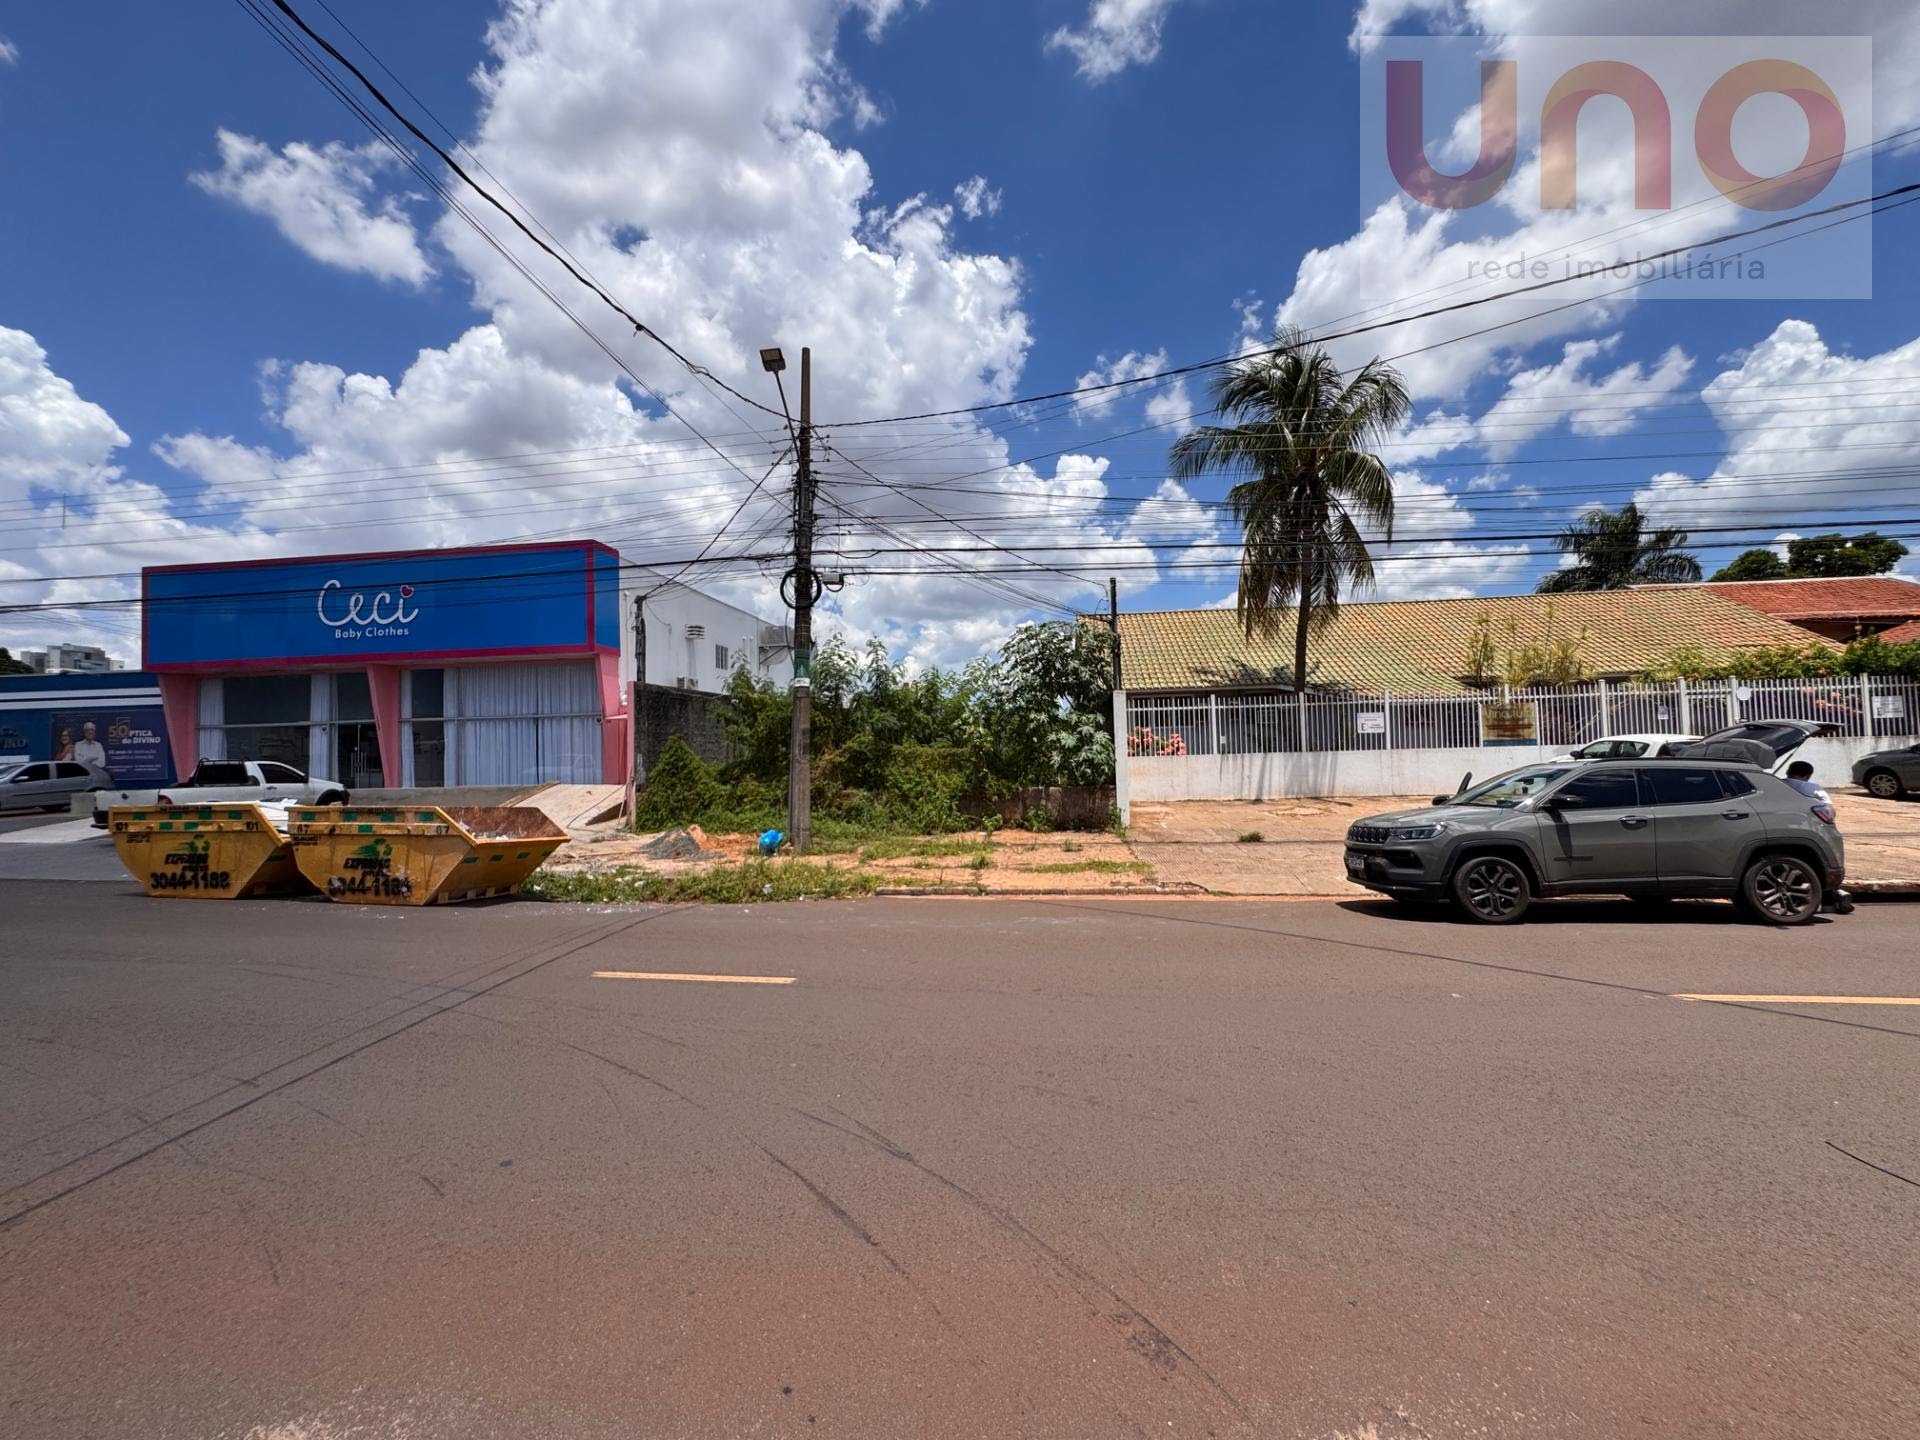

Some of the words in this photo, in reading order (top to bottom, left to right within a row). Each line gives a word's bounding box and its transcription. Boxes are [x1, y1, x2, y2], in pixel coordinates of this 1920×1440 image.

[317, 579, 419, 627] Ceci
[335, 629, 362, 640] Baby
[365, 627, 409, 637] Clothes
